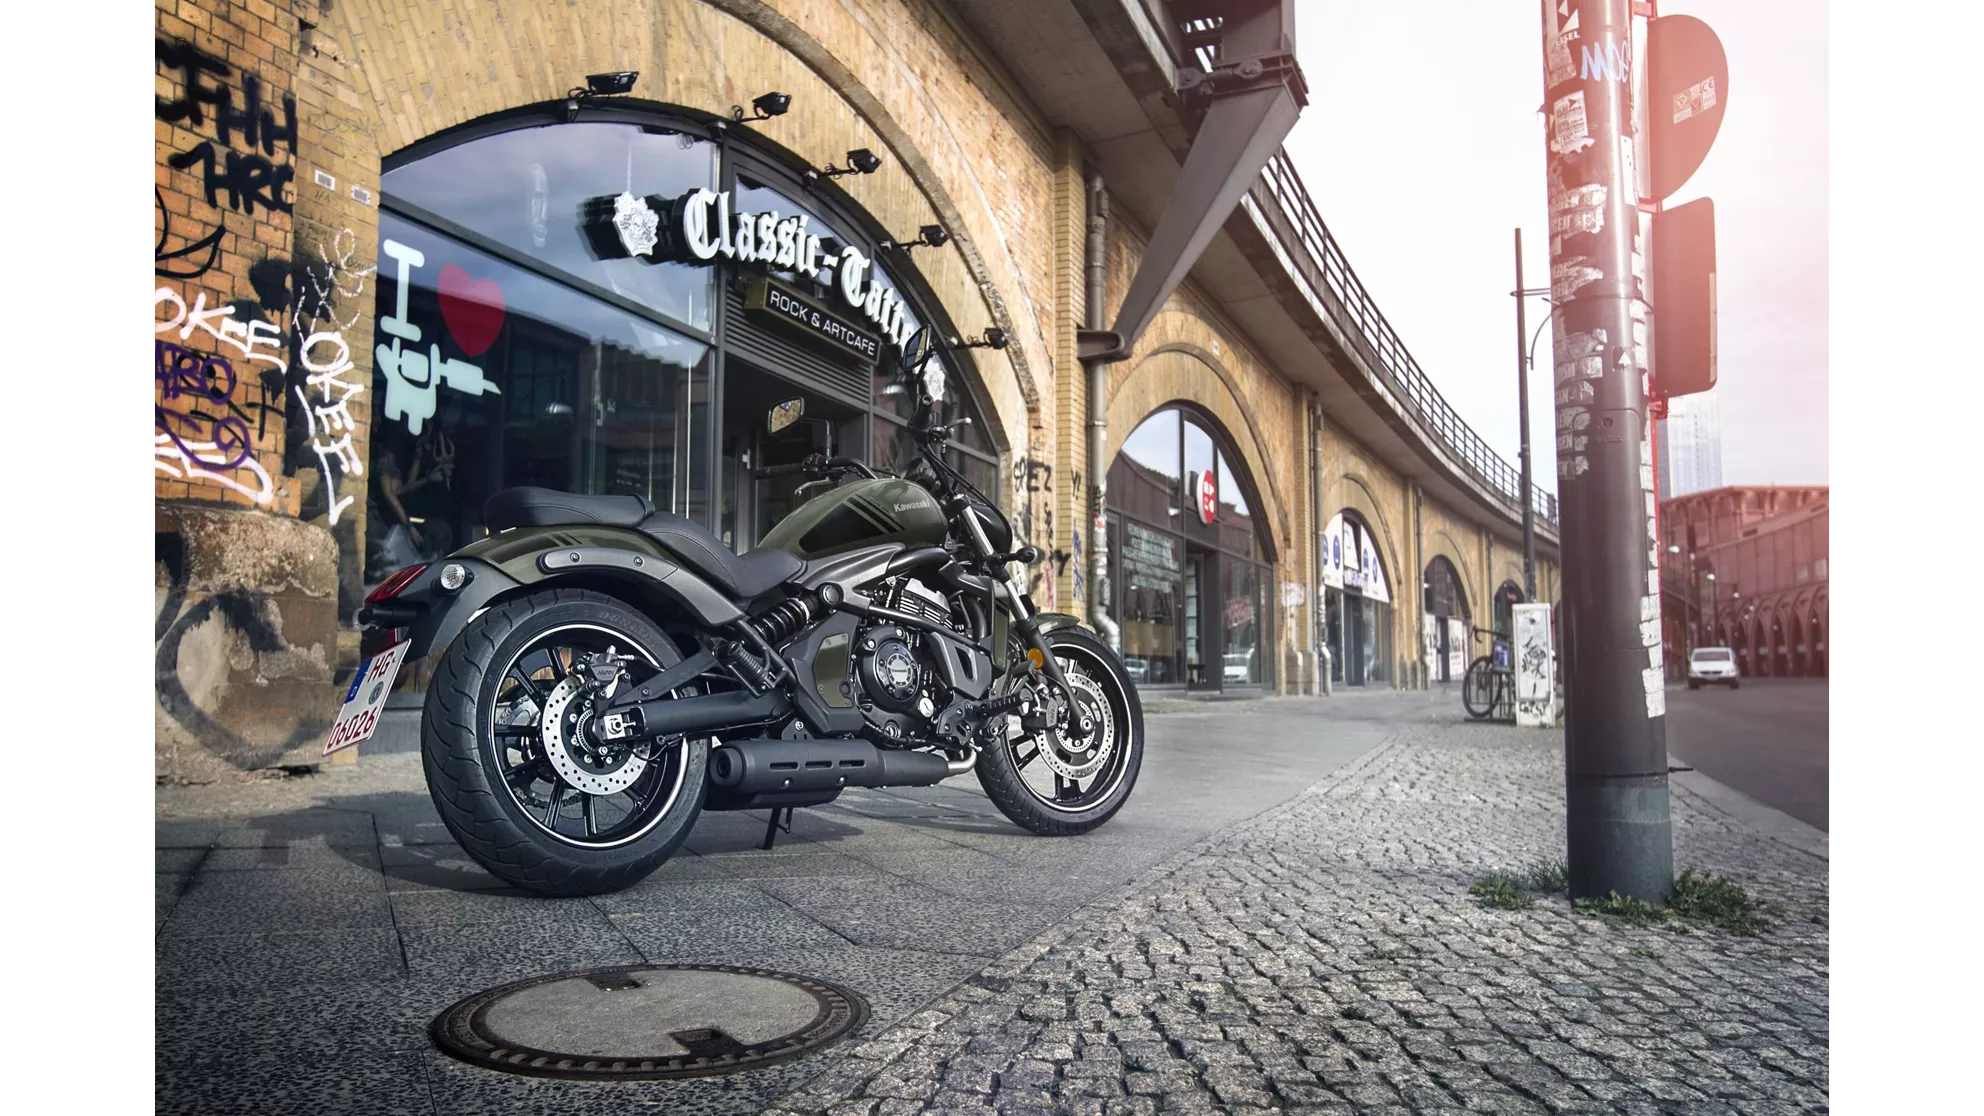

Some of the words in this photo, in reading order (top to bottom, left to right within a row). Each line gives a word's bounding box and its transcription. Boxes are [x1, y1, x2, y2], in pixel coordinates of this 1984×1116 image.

[380, 238, 426, 342] I
[769, 290, 808, 326] ROCK
[811, 311, 821, 328] &
[822, 318, 876, 357] ARTCAFE
[893, 499, 931, 513] Kawasaki
[367, 651, 395, 683] HG
[327, 706, 378, 749] 06026
